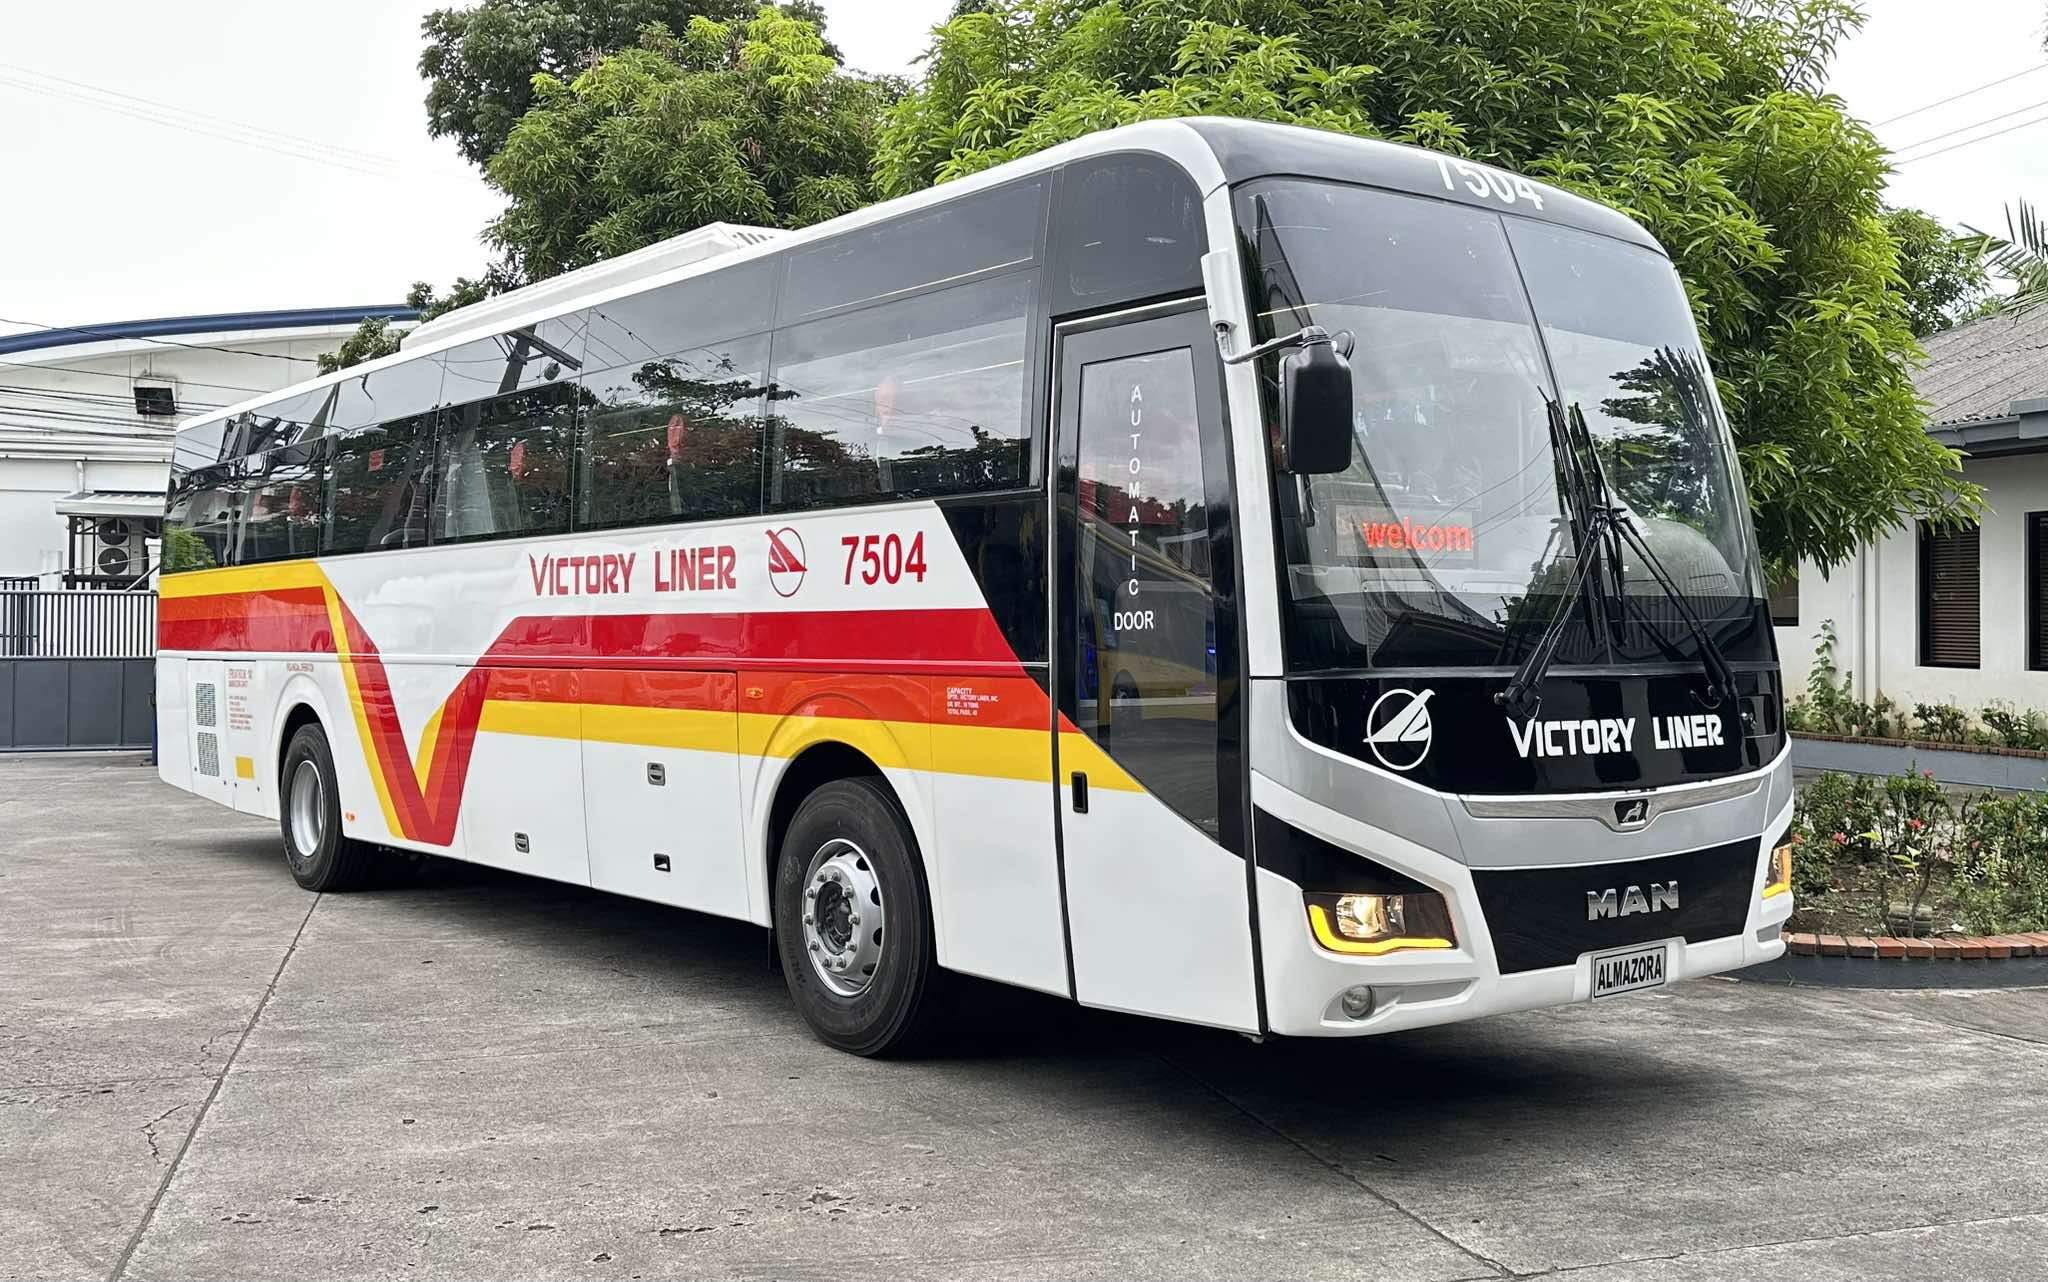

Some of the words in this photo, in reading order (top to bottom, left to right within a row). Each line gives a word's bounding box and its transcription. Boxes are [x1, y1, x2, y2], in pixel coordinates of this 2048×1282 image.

[1362, 516, 1474, 551] welcom
[528, 552, 637, 596] VICTORY
[655, 545, 736, 592] LINER
[841, 531, 927, 585] 7504
[1114, 610, 1154, 631] DOOR
[946, 687, 973, 695] CAPACITY
[1506, 716, 1636, 758] VICTORY
[1652, 714, 1724, 750] LINER
[1586, 880, 1680, 921] MAN
[1597, 953, 1662, 991] ALMAZORA
